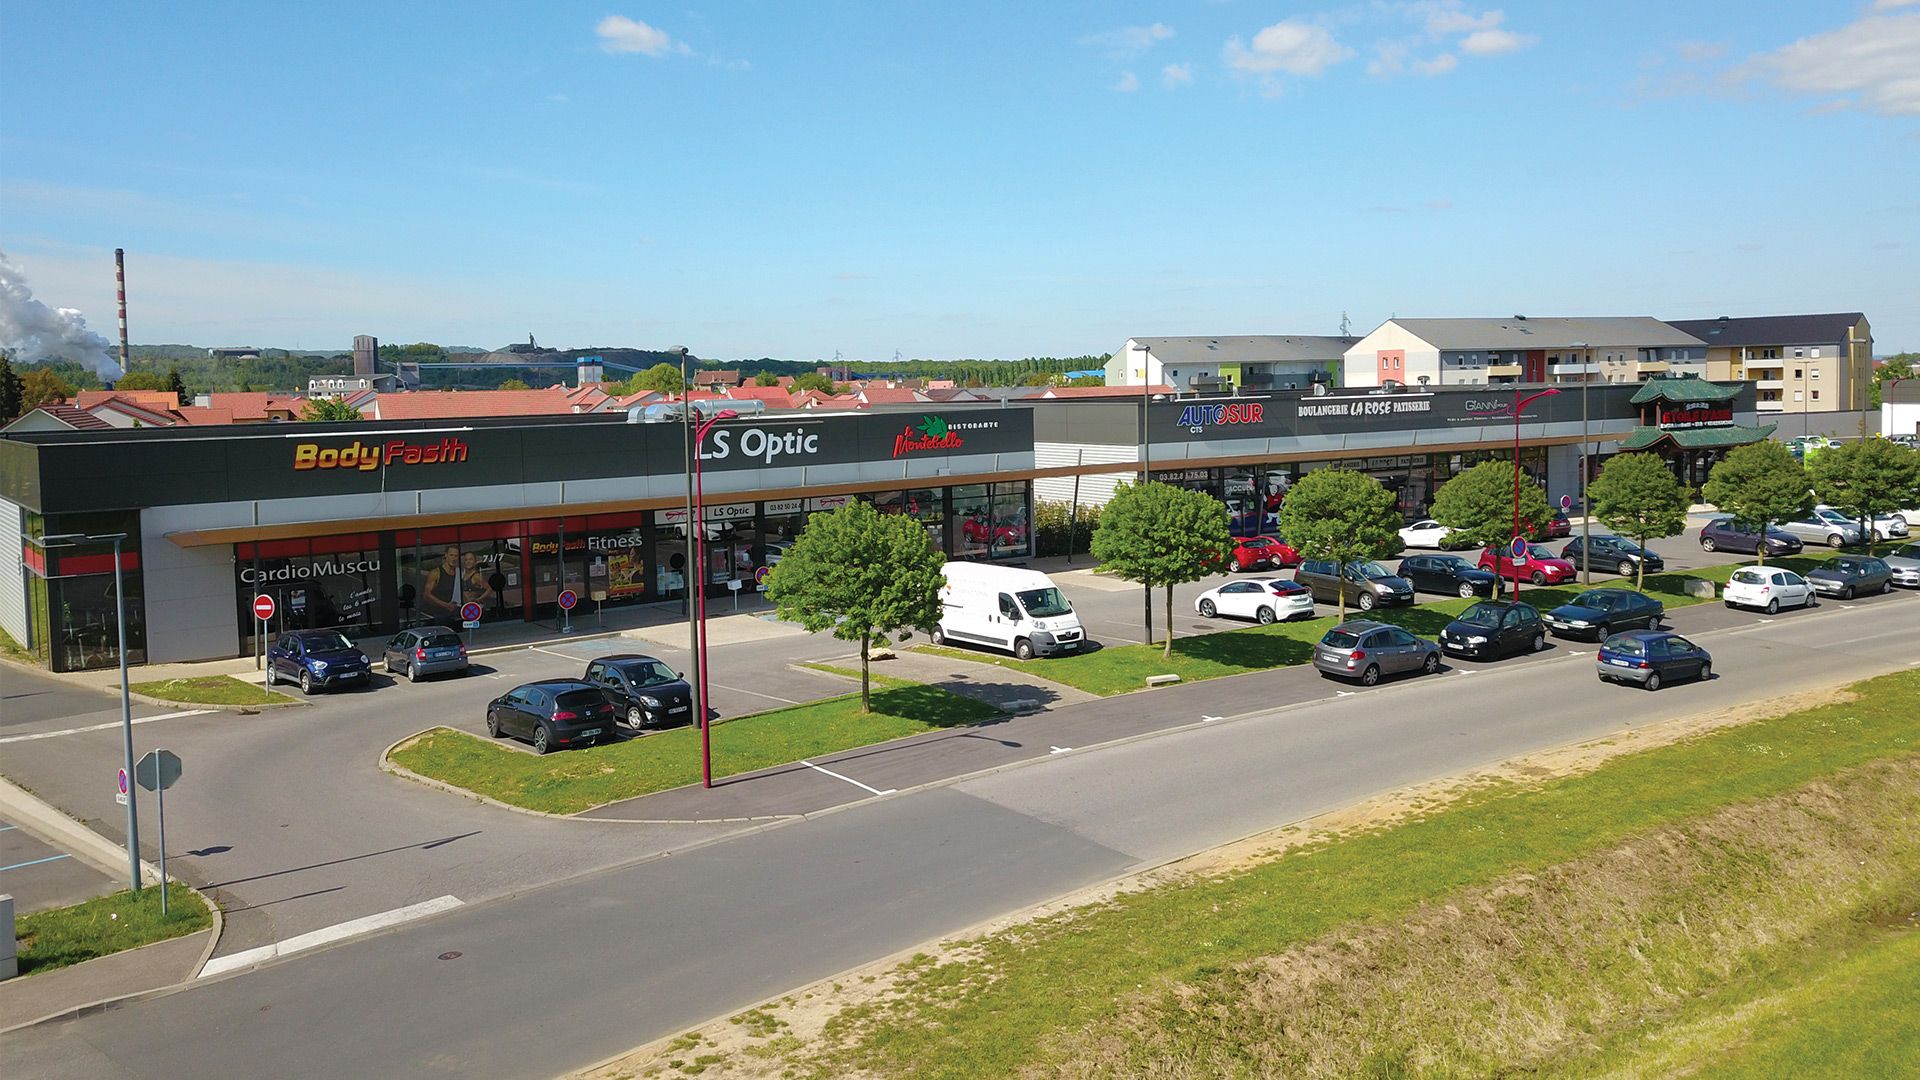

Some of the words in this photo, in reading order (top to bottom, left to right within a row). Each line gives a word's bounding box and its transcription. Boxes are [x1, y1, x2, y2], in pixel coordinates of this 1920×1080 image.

[1177, 403, 1264, 426] AUTOSUR
[1298, 404, 1349, 417] BOULANGERIE
[1350, 402, 1363, 416] LA
[1364, 401, 1391, 415] ROSE
[1393, 401, 1431, 413] PATISSERIE
[947, 421, 999, 430] RISTORANTE
[1190, 426, 1203, 434] CTS
[740, 428, 819, 464] Optic
[893, 431, 964, 459] Montebello
[294, 441, 380, 470] Body
[384, 437, 468, 466] Fasth
[713, 506, 724, 517] LS
[726, 505, 750, 518] Optic
[588, 535, 643, 551] Fitness
